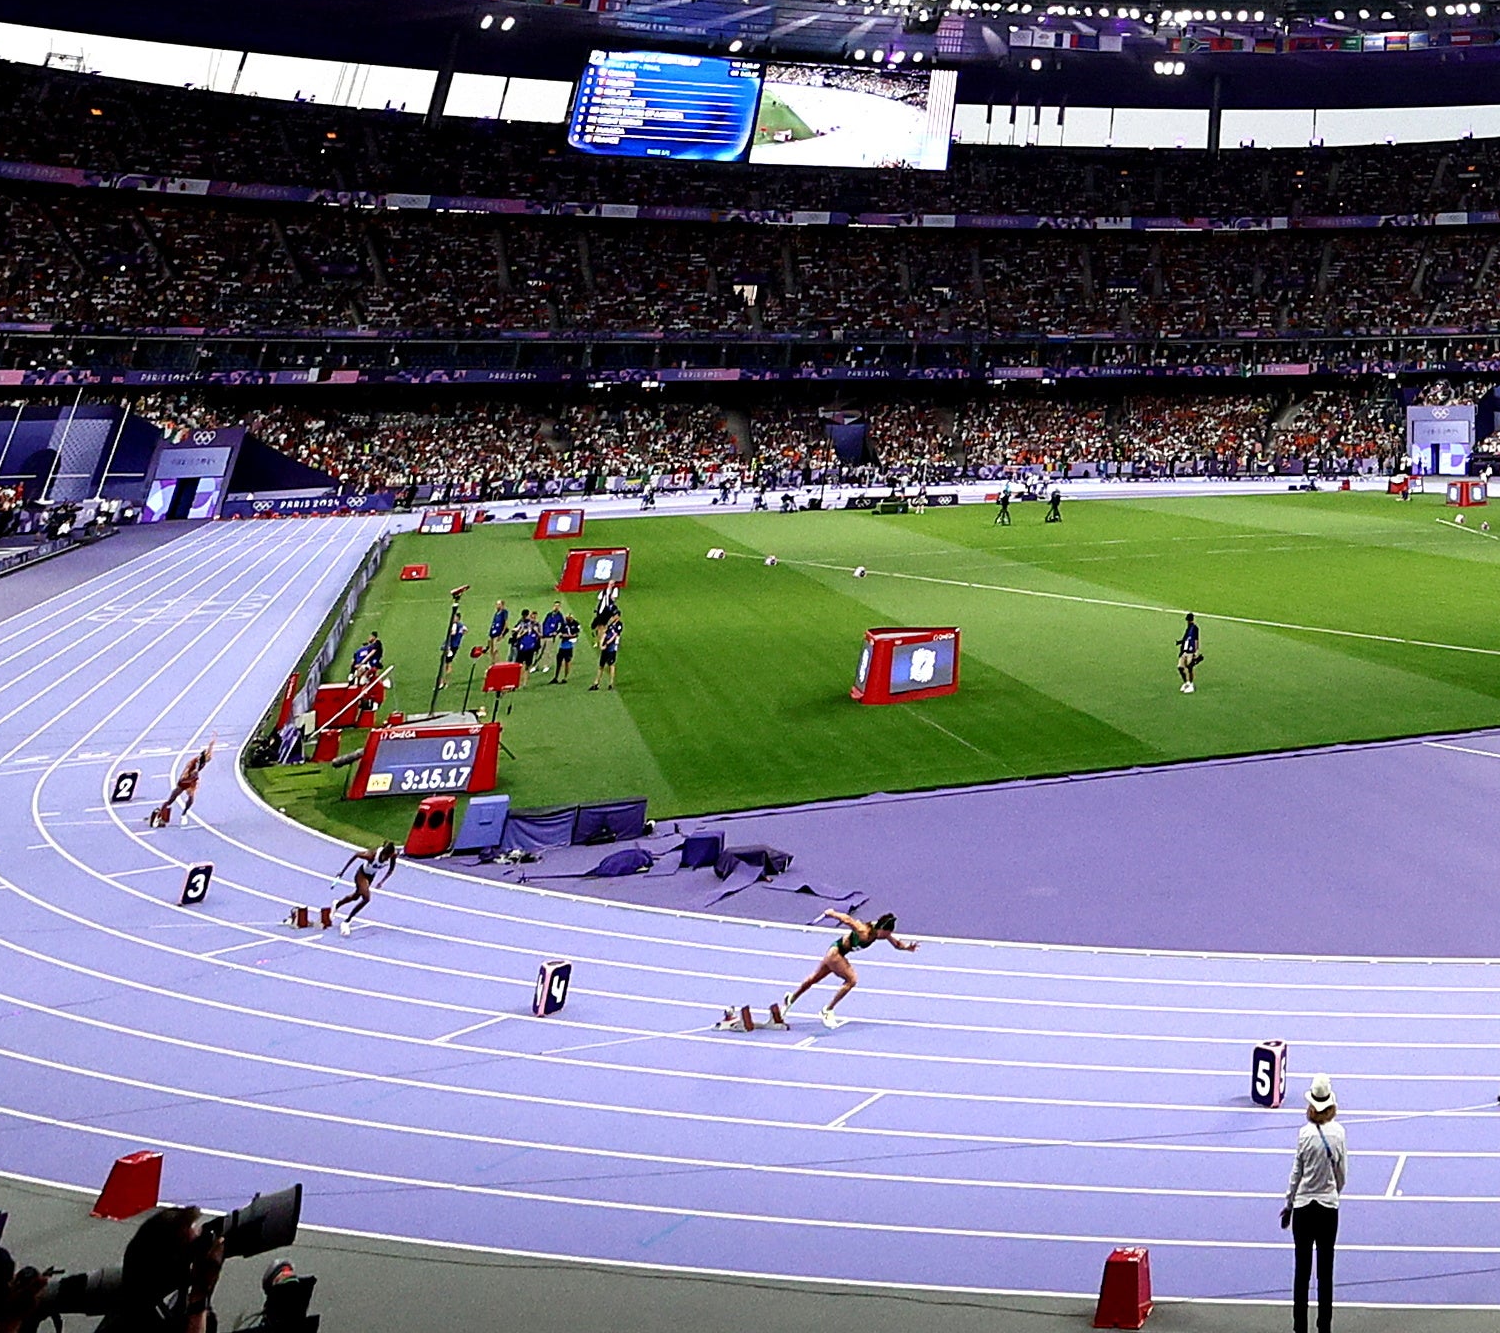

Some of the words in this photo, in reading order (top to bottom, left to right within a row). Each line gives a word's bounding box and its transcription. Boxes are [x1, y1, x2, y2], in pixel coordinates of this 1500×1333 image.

[280, 500, 310, 509] PARIS
[312, 498, 340, 508] 2024
[388, 730, 416, 740] OMEGA
[441, 739, 472, 761] 0.3
[116, 778, 133, 798] 2
[400, 767, 471, 791] 3:15.17
[187, 874, 205, 899] 3
[551, 975, 566, 1004] 4
[1256, 1060, 1271, 1096] 5
